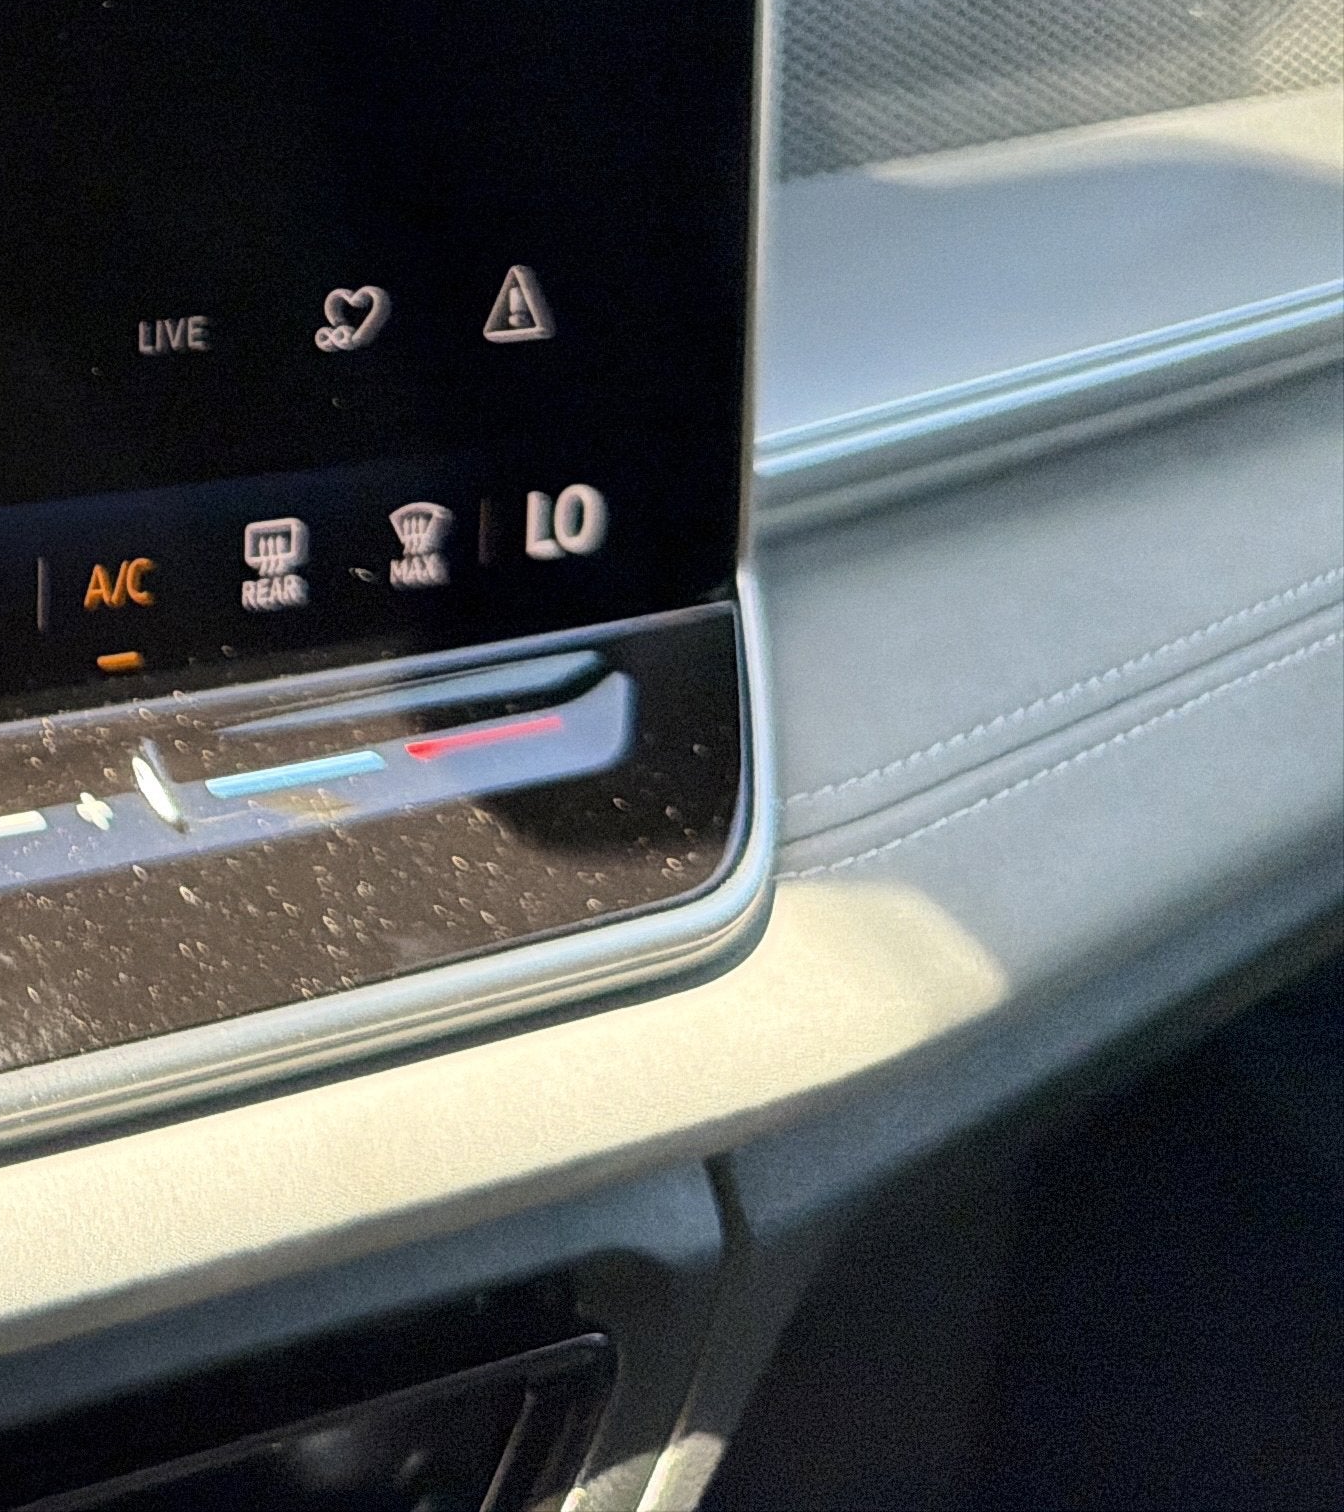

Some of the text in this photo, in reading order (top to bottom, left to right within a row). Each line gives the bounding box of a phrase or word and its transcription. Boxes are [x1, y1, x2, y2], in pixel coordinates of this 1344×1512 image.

[138, 316, 209, 355] LIVE
[526, 485, 608, 561] LO
[84, 557, 155, 611] A/C
[389, 552, 449, 588] MAX
[241, 576, 309, 611] REAR
